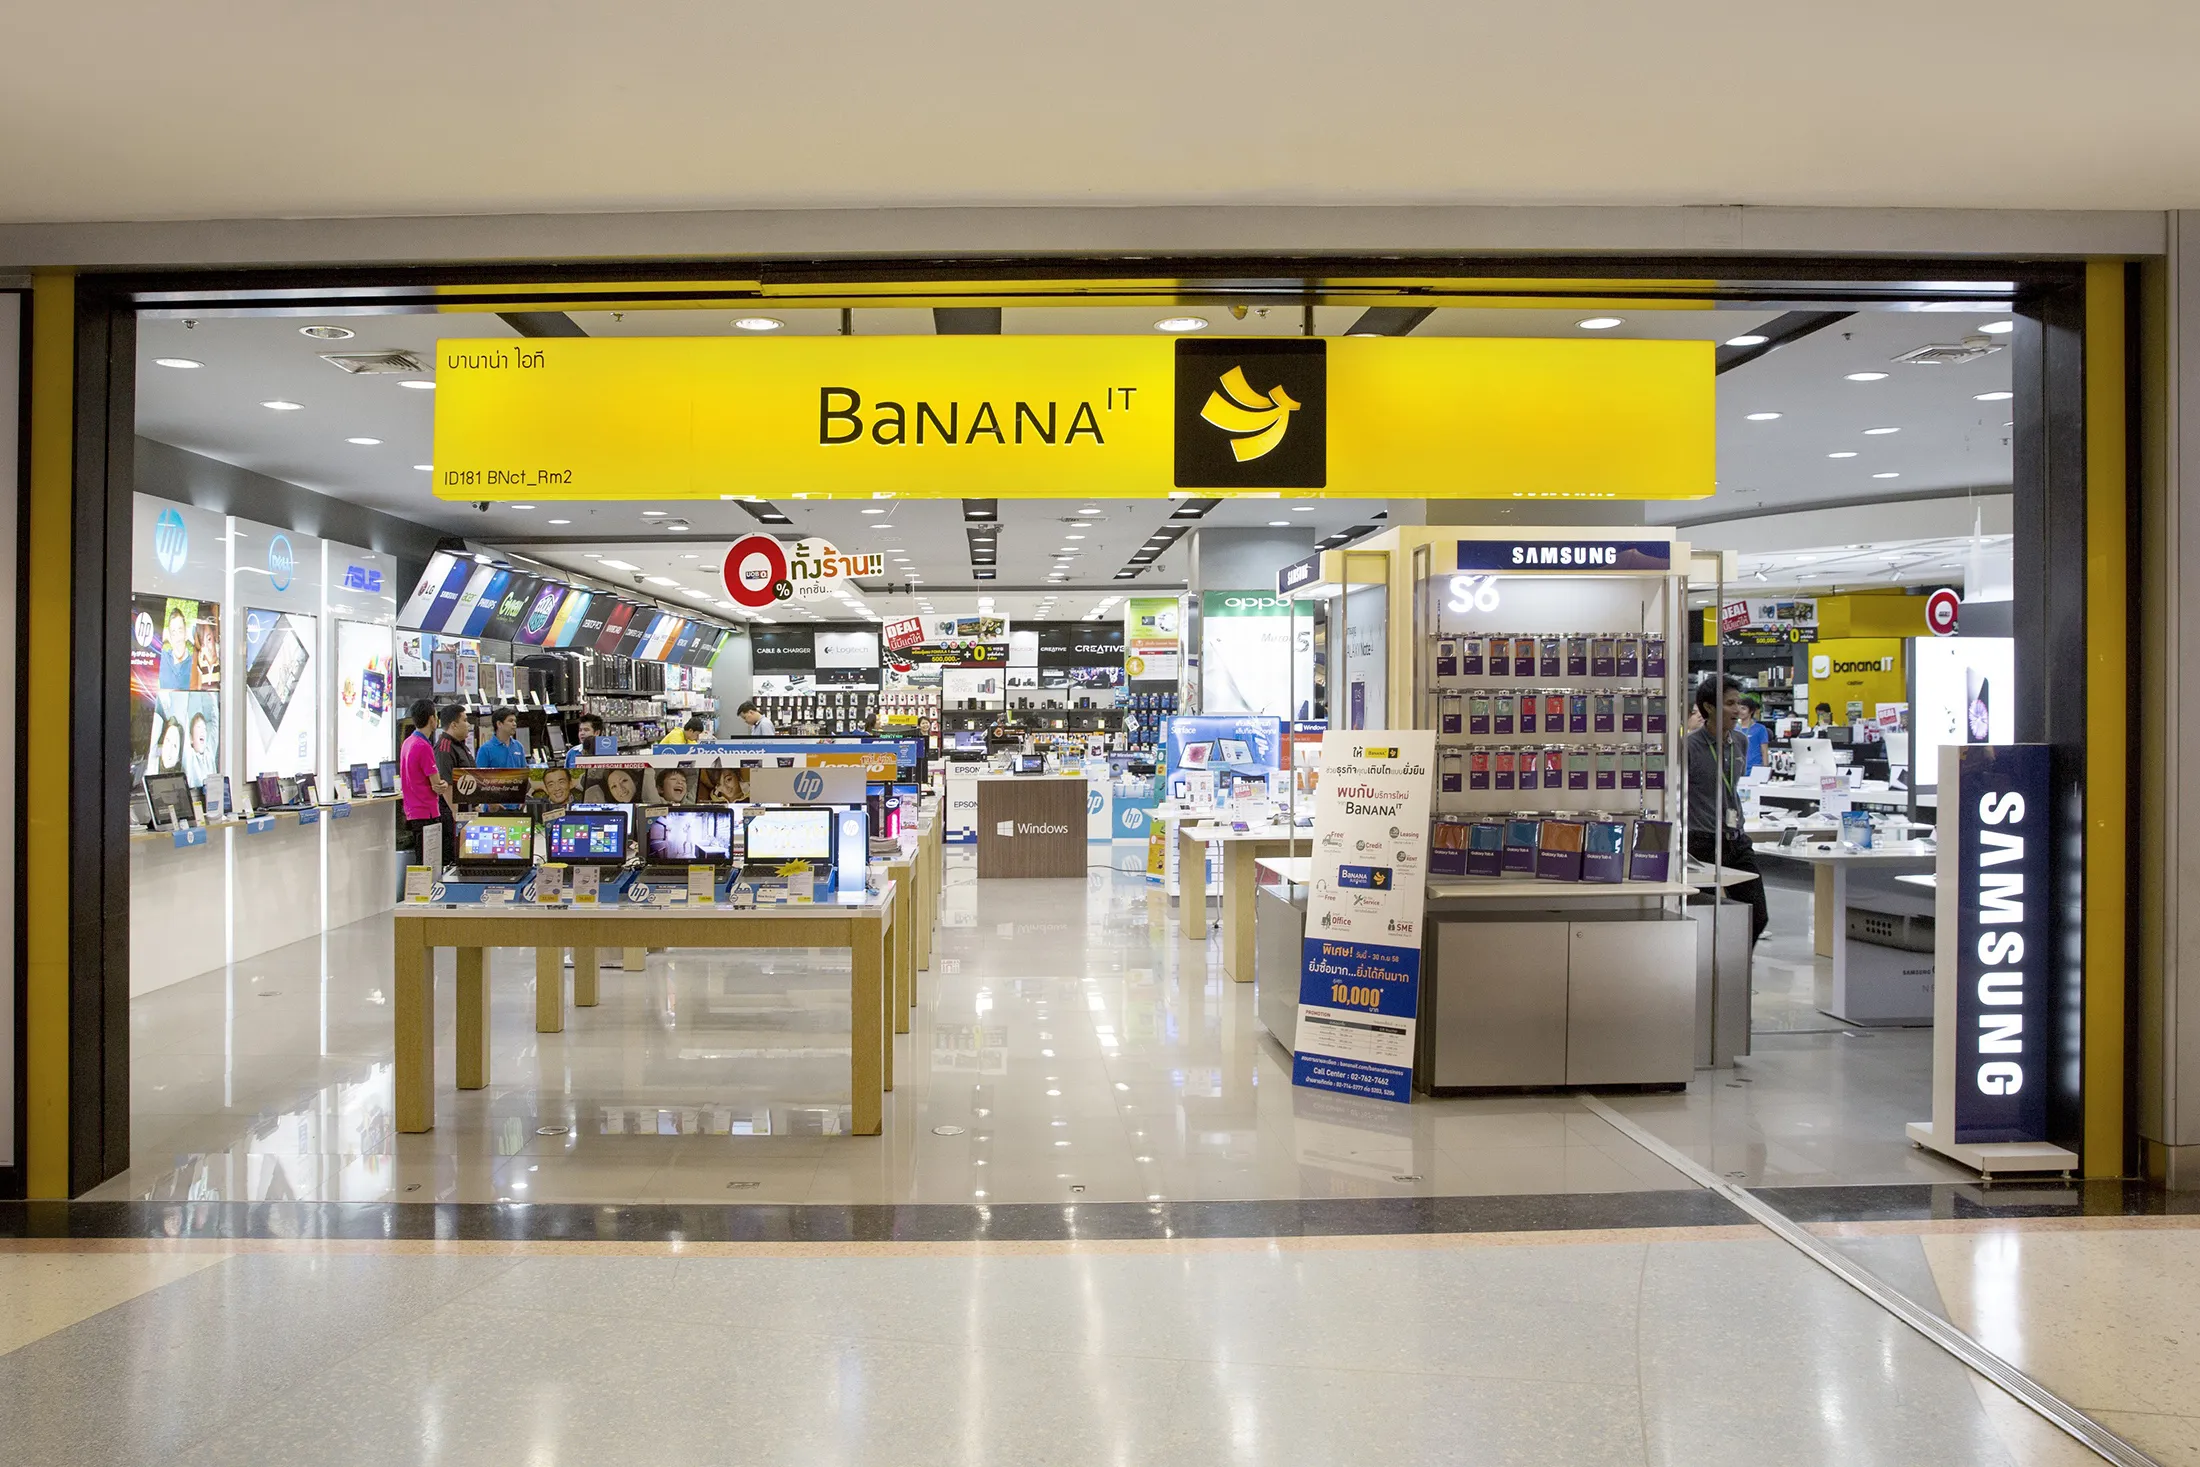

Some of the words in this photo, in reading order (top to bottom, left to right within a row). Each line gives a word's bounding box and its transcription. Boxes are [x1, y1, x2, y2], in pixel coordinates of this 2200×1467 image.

[448, 351, 508, 370] บานาน่า
[514, 347, 545, 370] ไอที
[1107, 387, 1138, 411] IT
[443, 471, 481, 486] ID181
[487, 469, 573, 487] BNct_Rm2
[791, 543, 882, 580] ทั้งร้าน!!
[1512, 547, 1617, 565] SAMSUNG
[799, 581, 833, 598] ทุกชิ้น..
[1448, 575, 1500, 613] S6
[886, 619, 919, 638] DEAL
[836, 646, 869, 655] Logitech
[1171, 727, 1197, 735] Surface
[796, 770, 822, 801] hp
[1124, 808, 1142, 829] hp
[1017, 822, 1069, 835] Windows
[1330, 831, 1344, 839] Free
[1400, 830, 1419, 839] Leasing
[1366, 842, 1383, 850] Credit
[629, 882, 648, 902] hp
[1363, 898, 1380, 907] Service
[1332, 915, 1352, 926] Office
[1396, 923, 1413, 933] SME
[1322, 942, 1353, 958] พิเศษ!
[1372, 953, 1380, 961] 30
[1976, 790, 2026, 1096] SAMSUNG
[1305, 1009, 1331, 1018] PROMOTION
[1313, 1067, 1325, 1076] Call
[1326, 1069, 1346, 1079] Center
